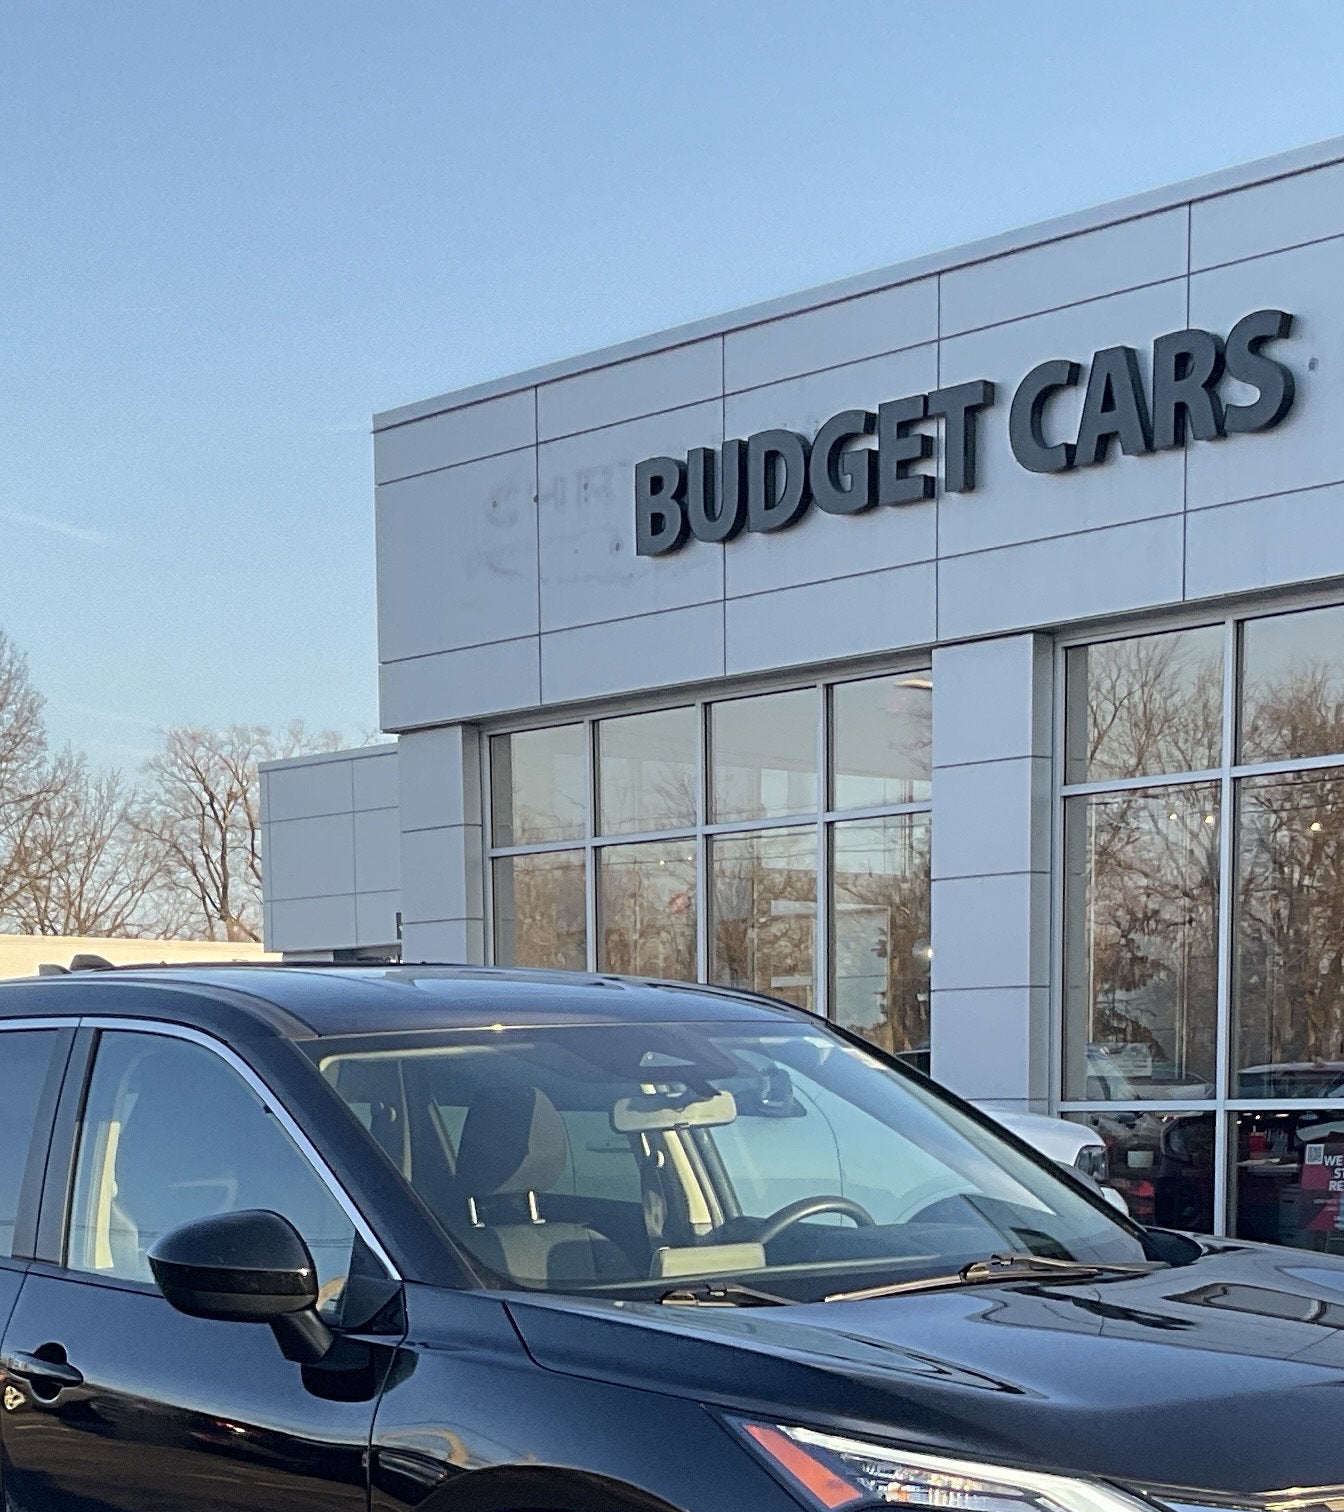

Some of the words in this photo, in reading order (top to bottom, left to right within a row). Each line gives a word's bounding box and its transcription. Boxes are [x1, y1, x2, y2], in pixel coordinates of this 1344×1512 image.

[635, 379, 996, 557] BUDGET
[1009, 308, 1295, 474] CARS
[1323, 1155, 1343, 1167] WE
